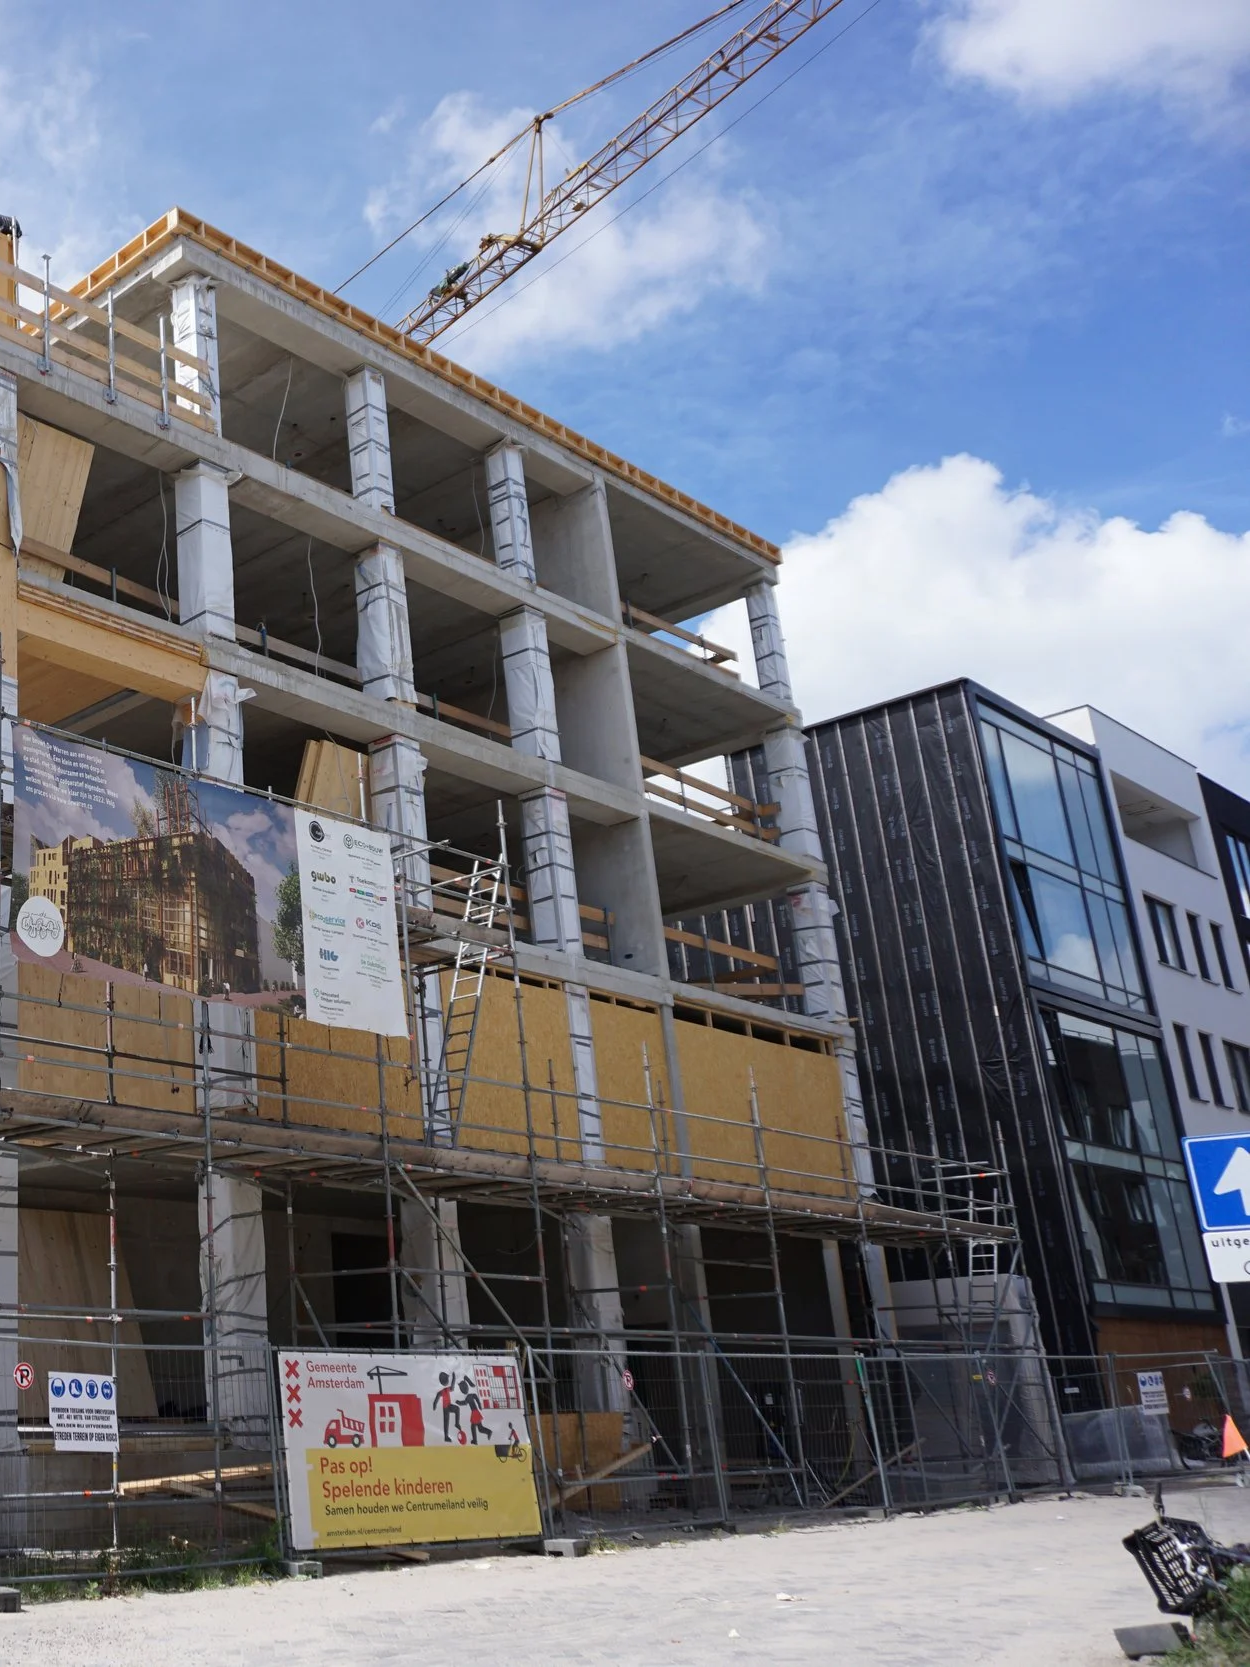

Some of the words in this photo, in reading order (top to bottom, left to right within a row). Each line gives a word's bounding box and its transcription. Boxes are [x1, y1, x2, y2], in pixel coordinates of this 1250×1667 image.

[53, 745, 69, 756] Warren
[306, 1360, 357, 1373] Gemeente
[307, 1376, 365, 1389] Amsterdam
[54, 1431, 72, 1440] ETREDEN
[72, 1432, 88, 1441] TERREIN
[89, 1433, 94, 1441] OP
[95, 1433, 105, 1441] EIGEN
[106, 1433, 117, 1442] RISICO
[320, 1456, 346, 1475] Pas
[350, 1456, 373, 1478] op!
[322, 1478, 391, 1503] Spelende
[394, 1477, 454, 1495] kinderen
[325, 1504, 355, 1516] Samen
[357, 1502, 390, 1515] houden
[391, 1503, 404, 1513] we
[405, 1499, 465, 1512] Centrumeiland
[467, 1497, 489, 1511] veilig
[326, 1526, 402, 1537] amsterdam.nl/centrumeiland
